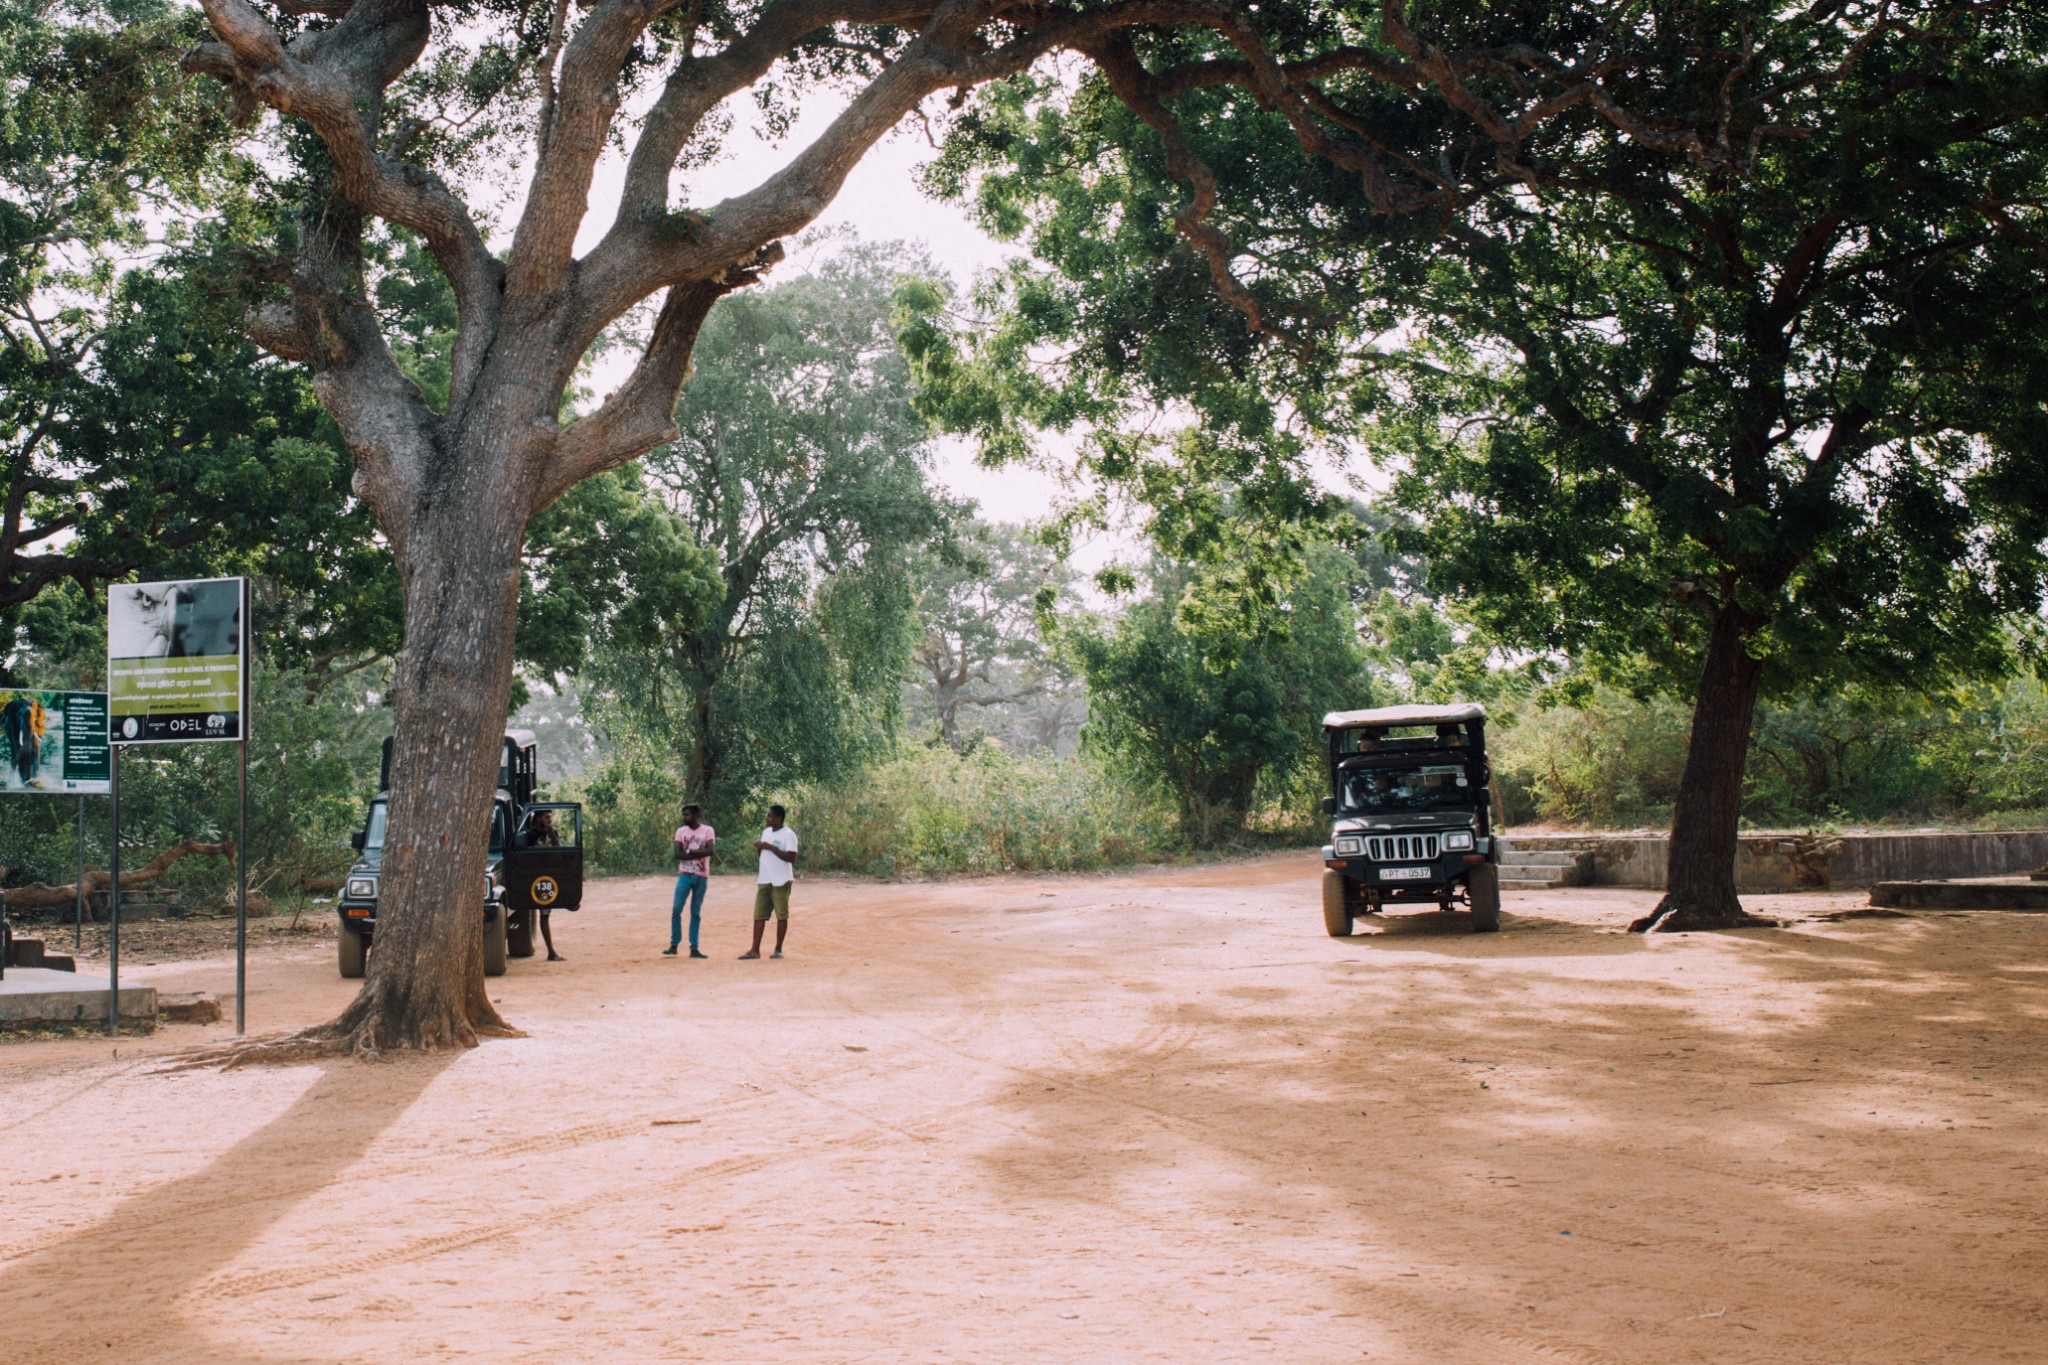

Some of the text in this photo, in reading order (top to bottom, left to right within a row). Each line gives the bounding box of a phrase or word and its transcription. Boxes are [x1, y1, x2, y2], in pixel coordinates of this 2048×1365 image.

[170, 719, 202, 731] ODEL
[1408, 868, 1429, 878] 0537
[536, 881, 552, 891] 138
